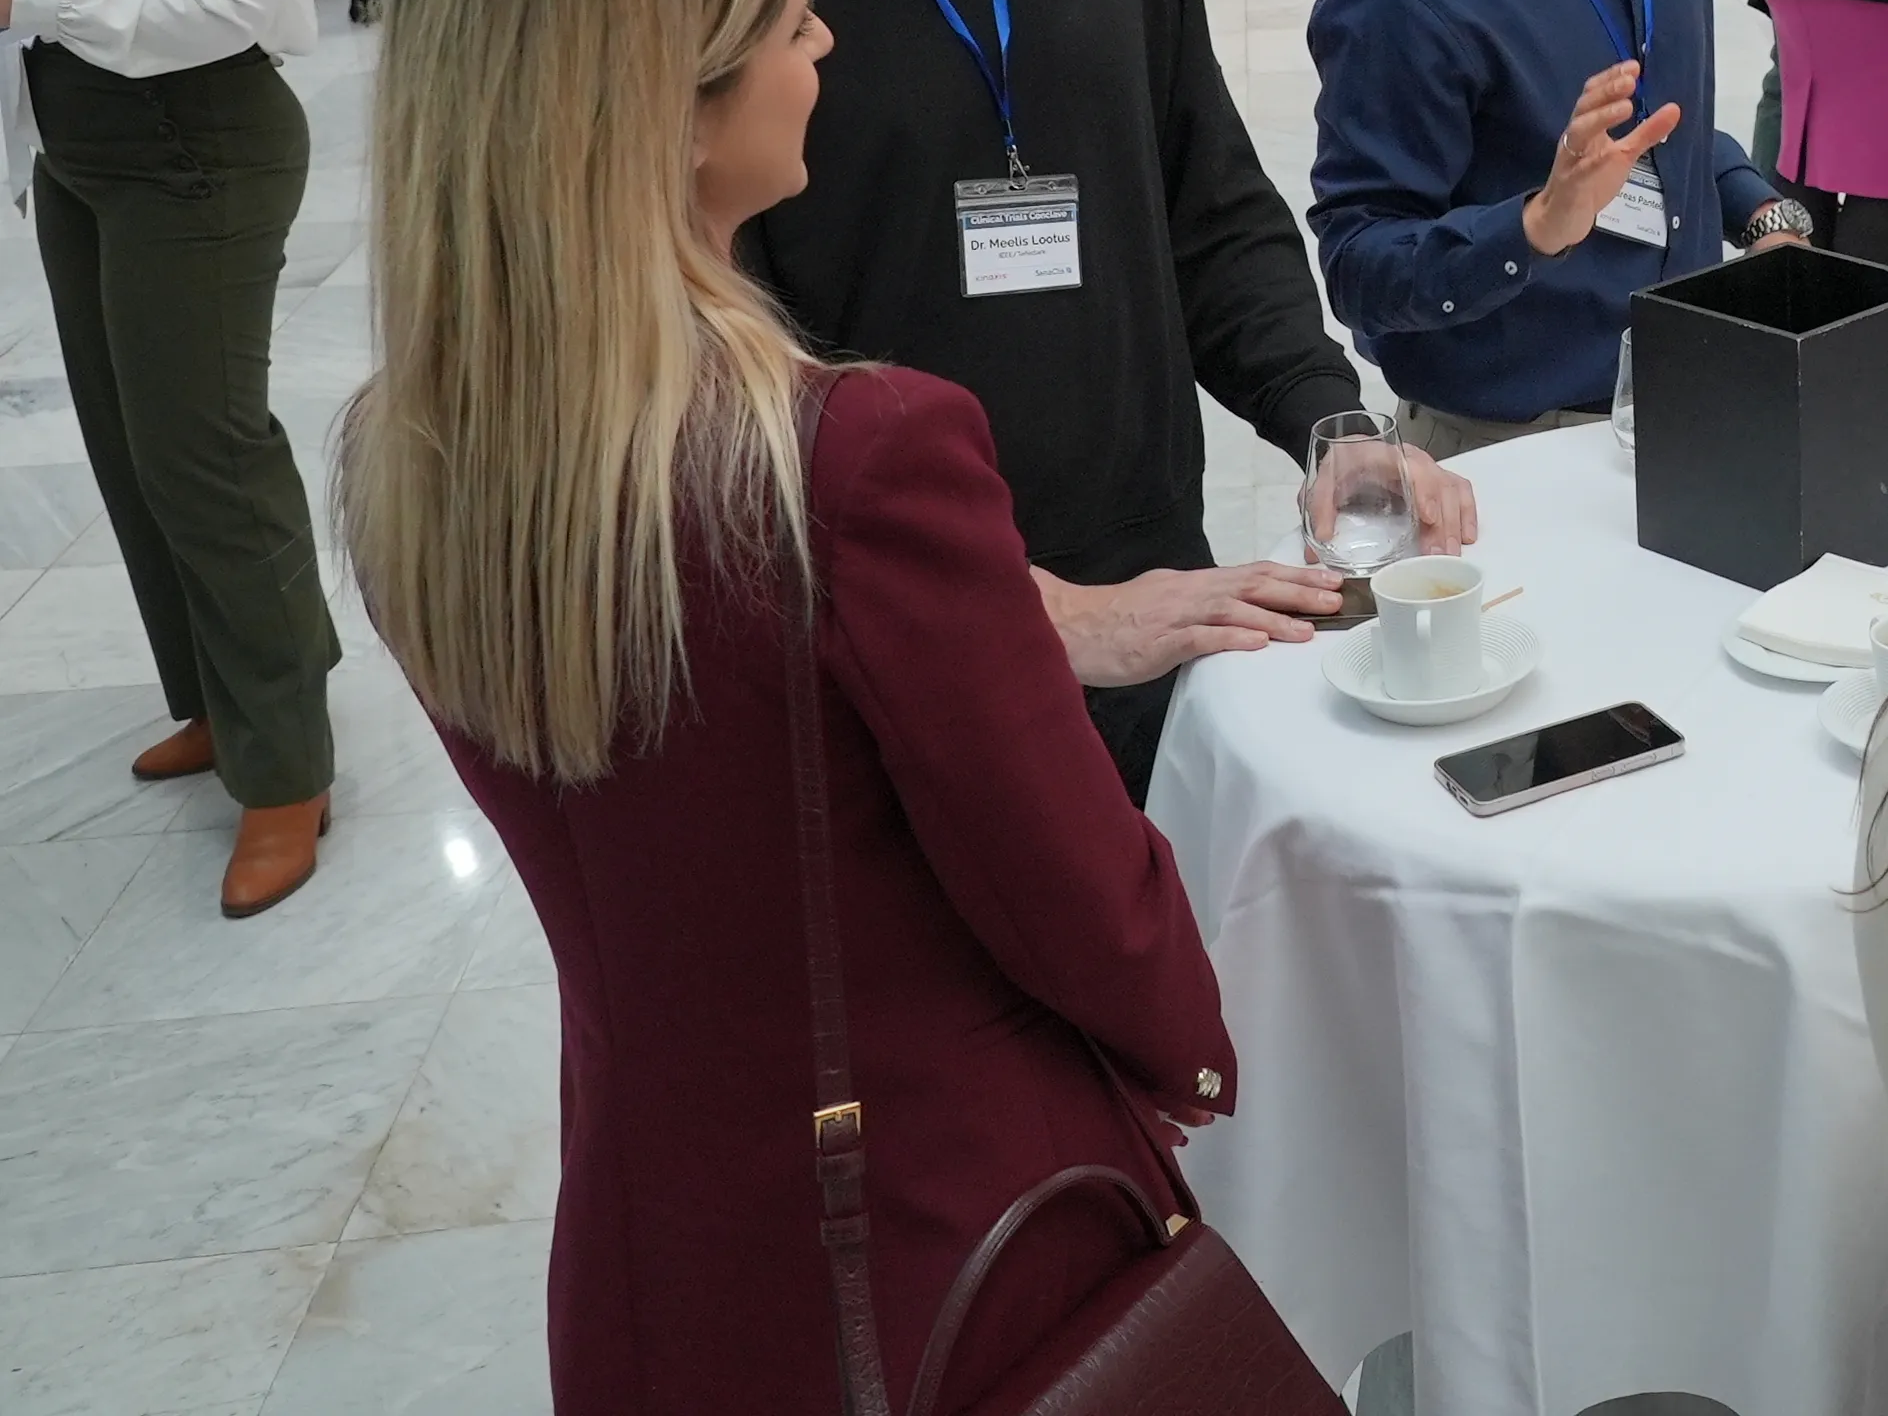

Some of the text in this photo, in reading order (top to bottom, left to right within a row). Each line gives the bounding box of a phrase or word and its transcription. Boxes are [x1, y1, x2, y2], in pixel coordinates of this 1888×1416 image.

[970, 209, 1068, 226] Clinical Trials Conclave
[971, 233, 1071, 251] Dr. Meelis Lootus
